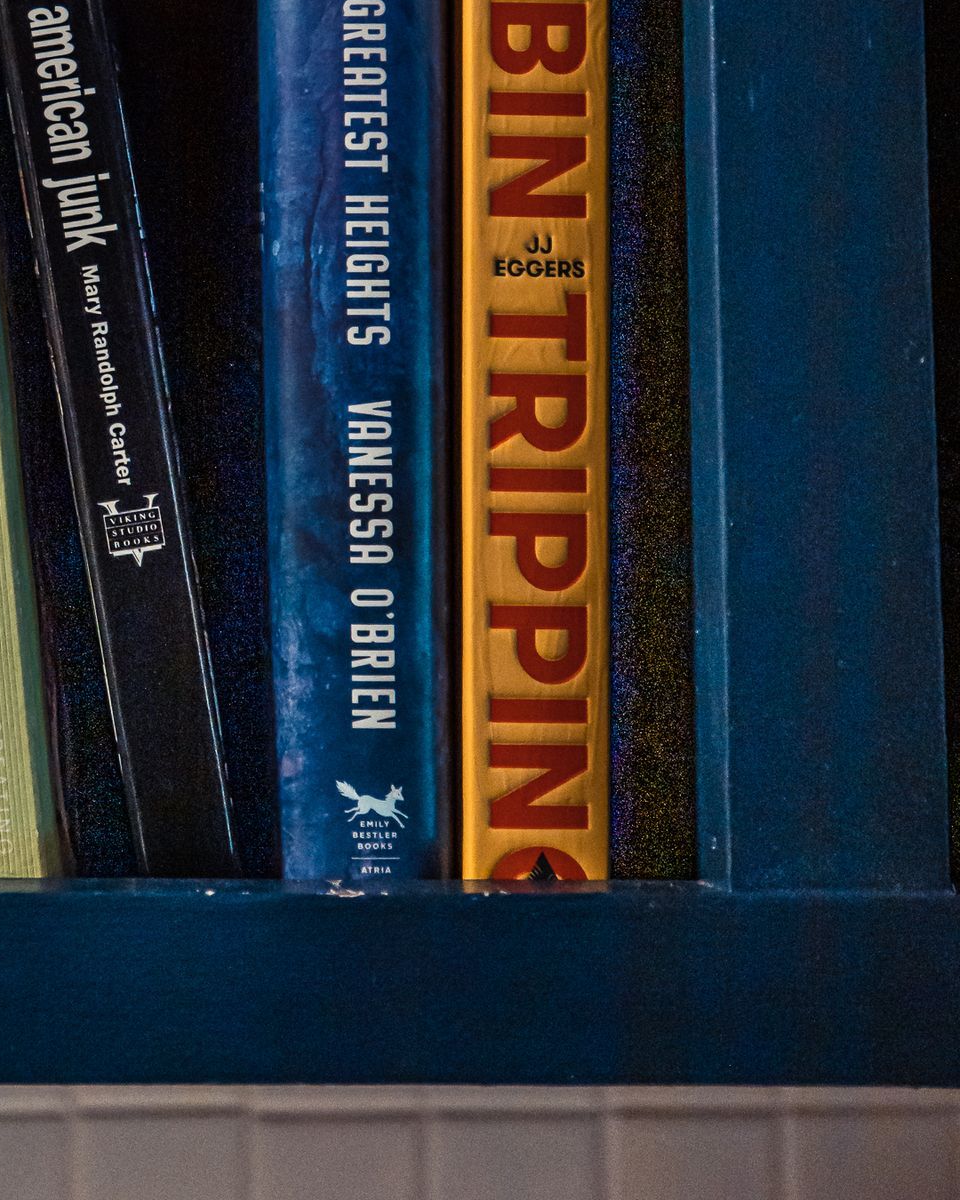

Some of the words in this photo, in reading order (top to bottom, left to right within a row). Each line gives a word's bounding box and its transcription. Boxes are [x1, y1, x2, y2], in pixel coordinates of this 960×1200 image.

[27, 5, 97, 165] american
[42, 173, 118, 253] junk
[525, 234, 553, 255] JJ
[344, 194, 391, 346] HEIGHTS
[492, 257, 586, 279] EGGERS
[81, 264, 102, 315] Mary
[91, 321, 123, 417] Randolph
[108, 422, 131, 487] Carter
[347, 400, 394, 565] VANESSA
[110, 511, 156, 525] VIKING
[112, 523, 158, 537] STUDIO
[113, 535, 160, 549] BOOKS
[349, 588, 397, 730] O'BRIEN
[360, 820, 389, 828] EMILY
[357, 842, 393, 850] BOOKS
[361, 866, 392, 874] ATRIA
